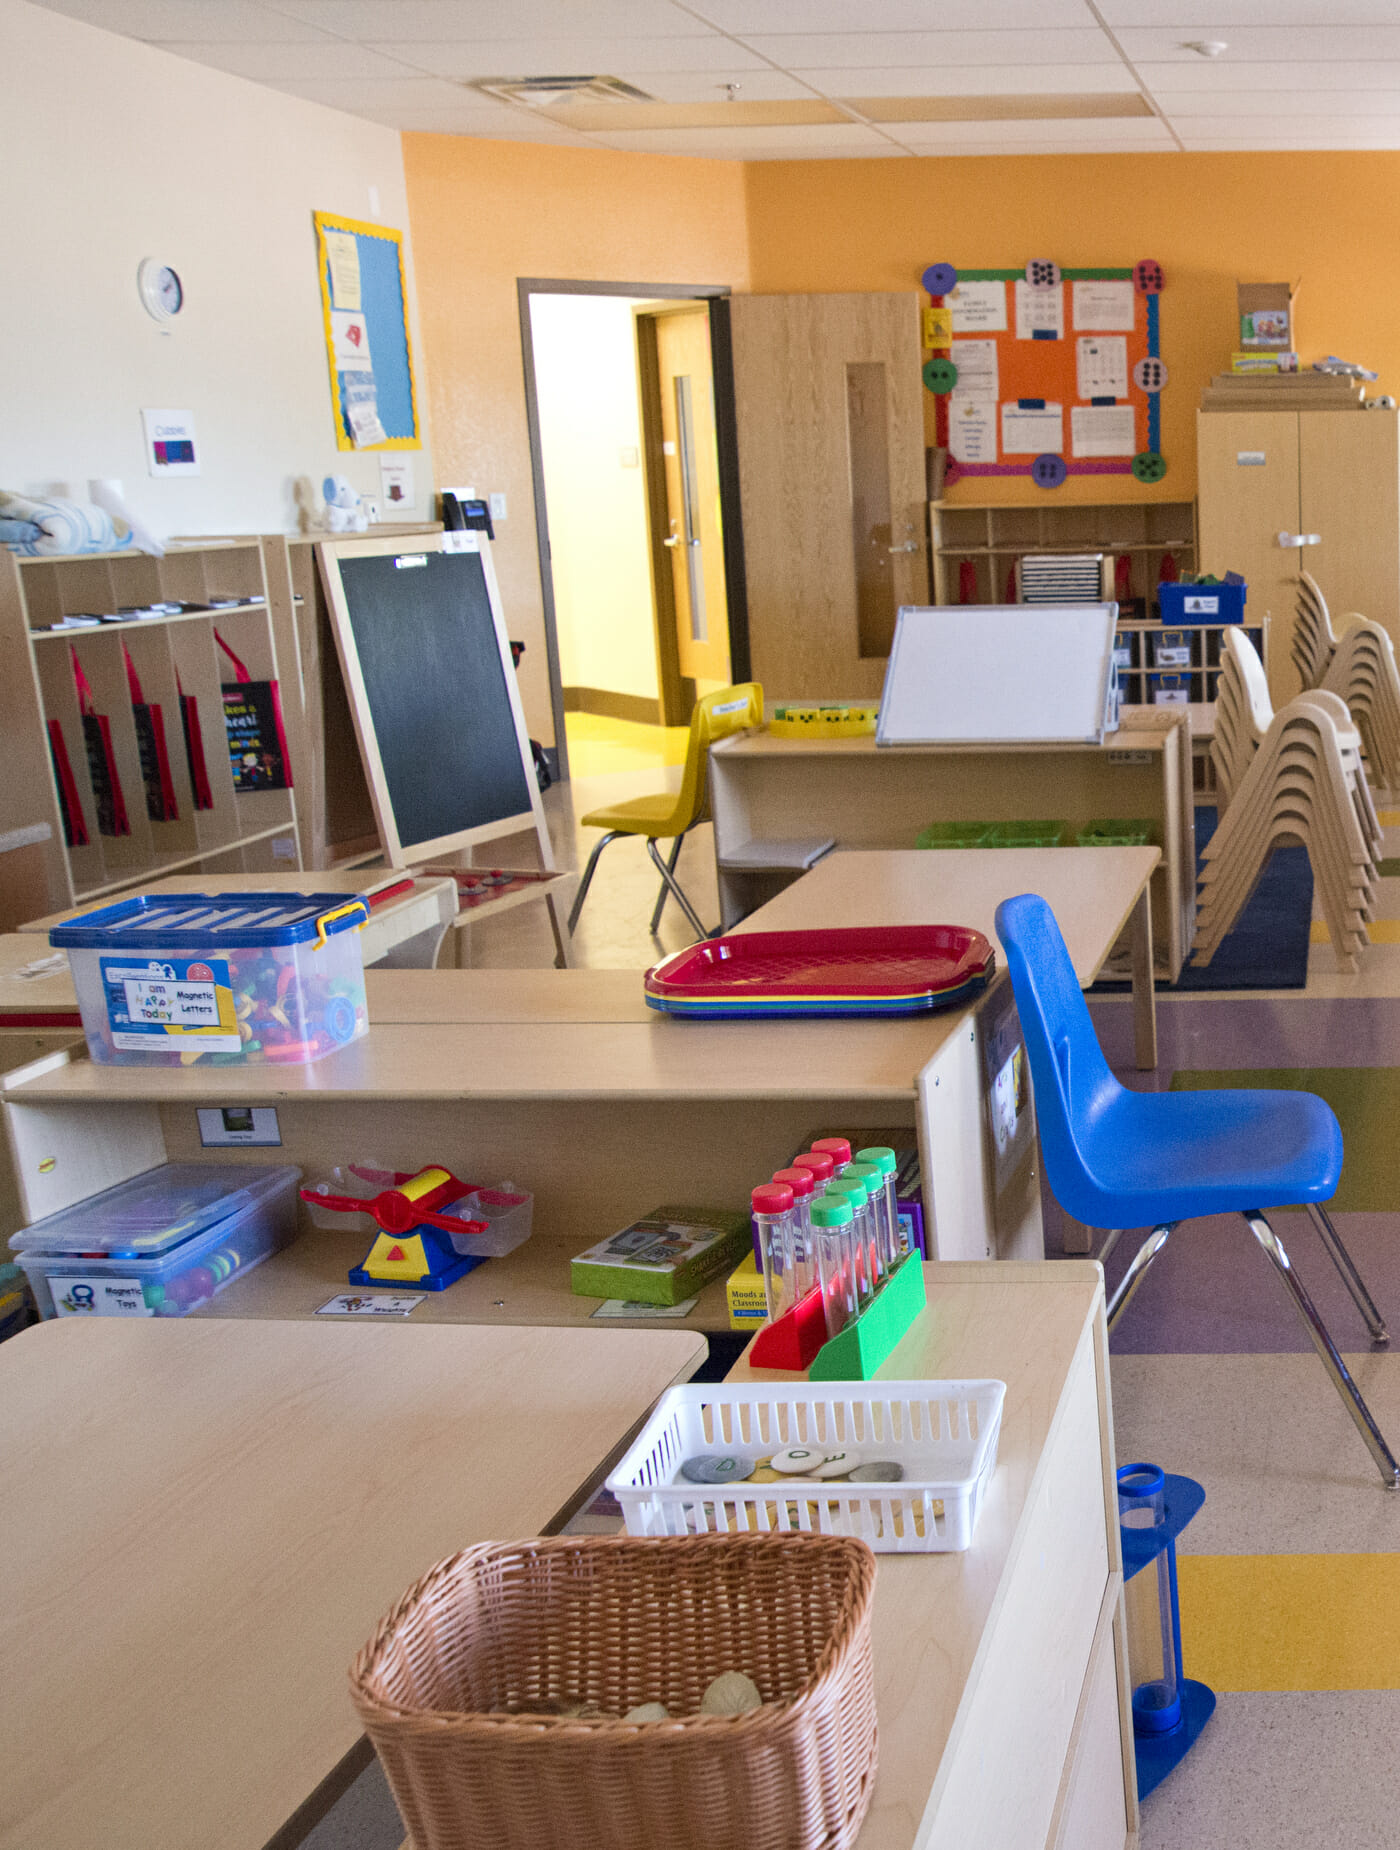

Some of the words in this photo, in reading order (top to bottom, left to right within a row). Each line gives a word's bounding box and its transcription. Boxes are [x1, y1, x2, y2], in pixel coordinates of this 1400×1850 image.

[176, 991, 214, 1002] Magnetic
[141, 1008, 173, 1021] Today
[181, 1004, 213, 1015] Letters
[105, 1287, 142, 1297] Magnetic
[731, 1290, 758, 1298] Moods
[115, 1299, 137, 1309] Toys
